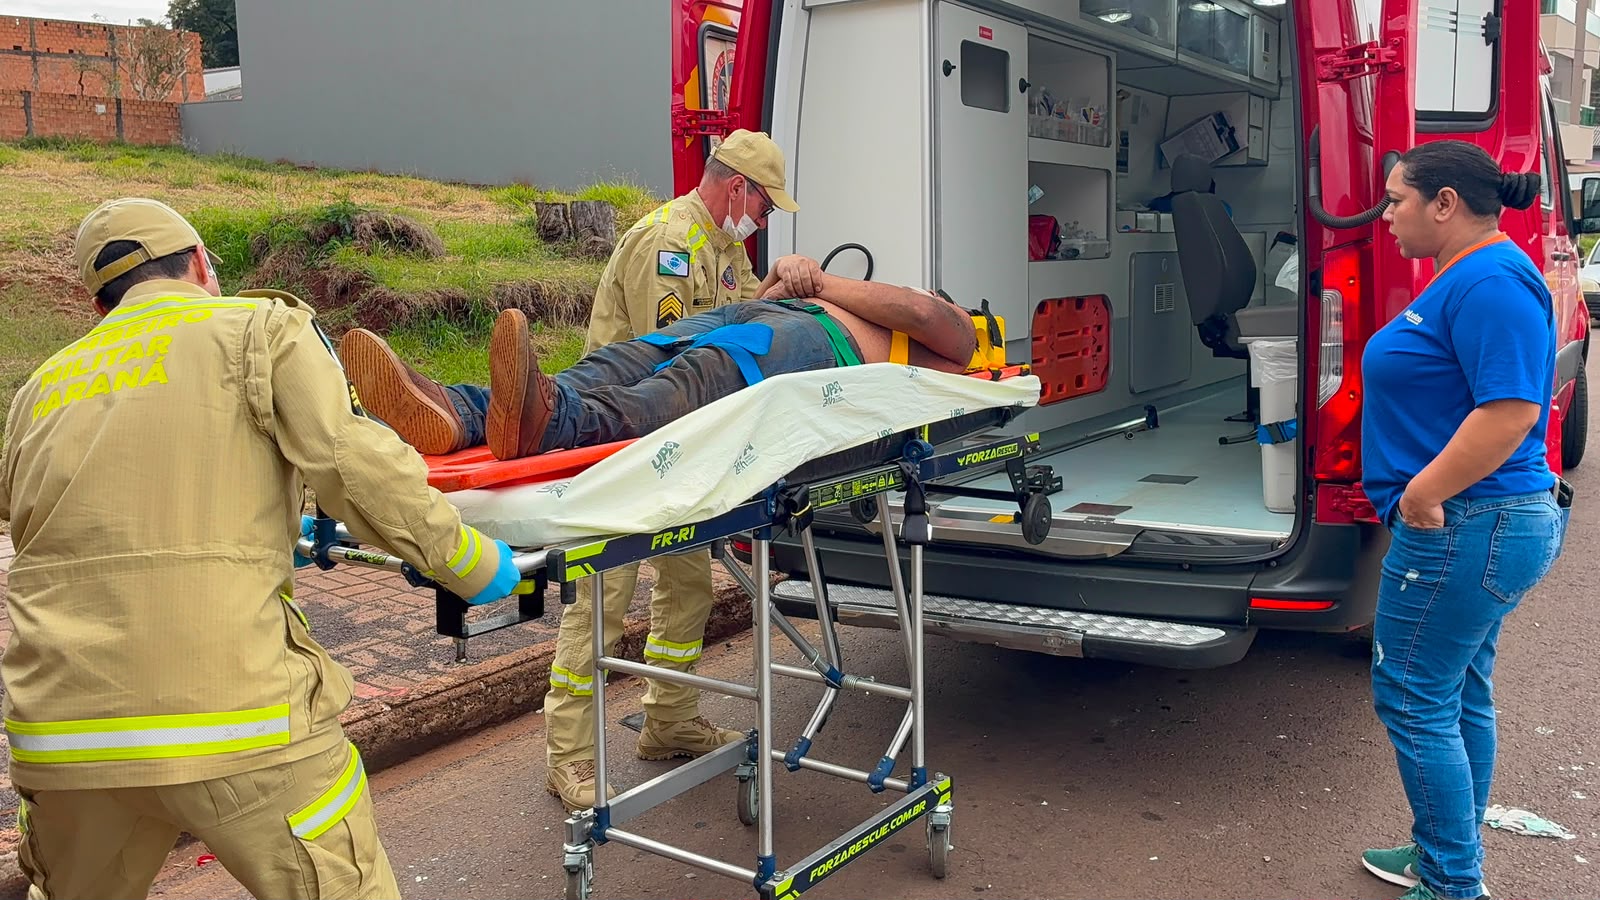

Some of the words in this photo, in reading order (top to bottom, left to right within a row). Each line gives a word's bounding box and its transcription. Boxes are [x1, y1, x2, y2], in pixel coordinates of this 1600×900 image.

[50, 309, 213, 367] MBEIRO
[40, 334, 173, 393] MILITAR
[821, 380, 844, 398] UPA
[651, 441, 680, 470] UPA
[656, 460, 673, 479] 24h
[965, 447, 997, 466] FORZA
[809, 799, 927, 883] FORZARESCUE.COM.BR
